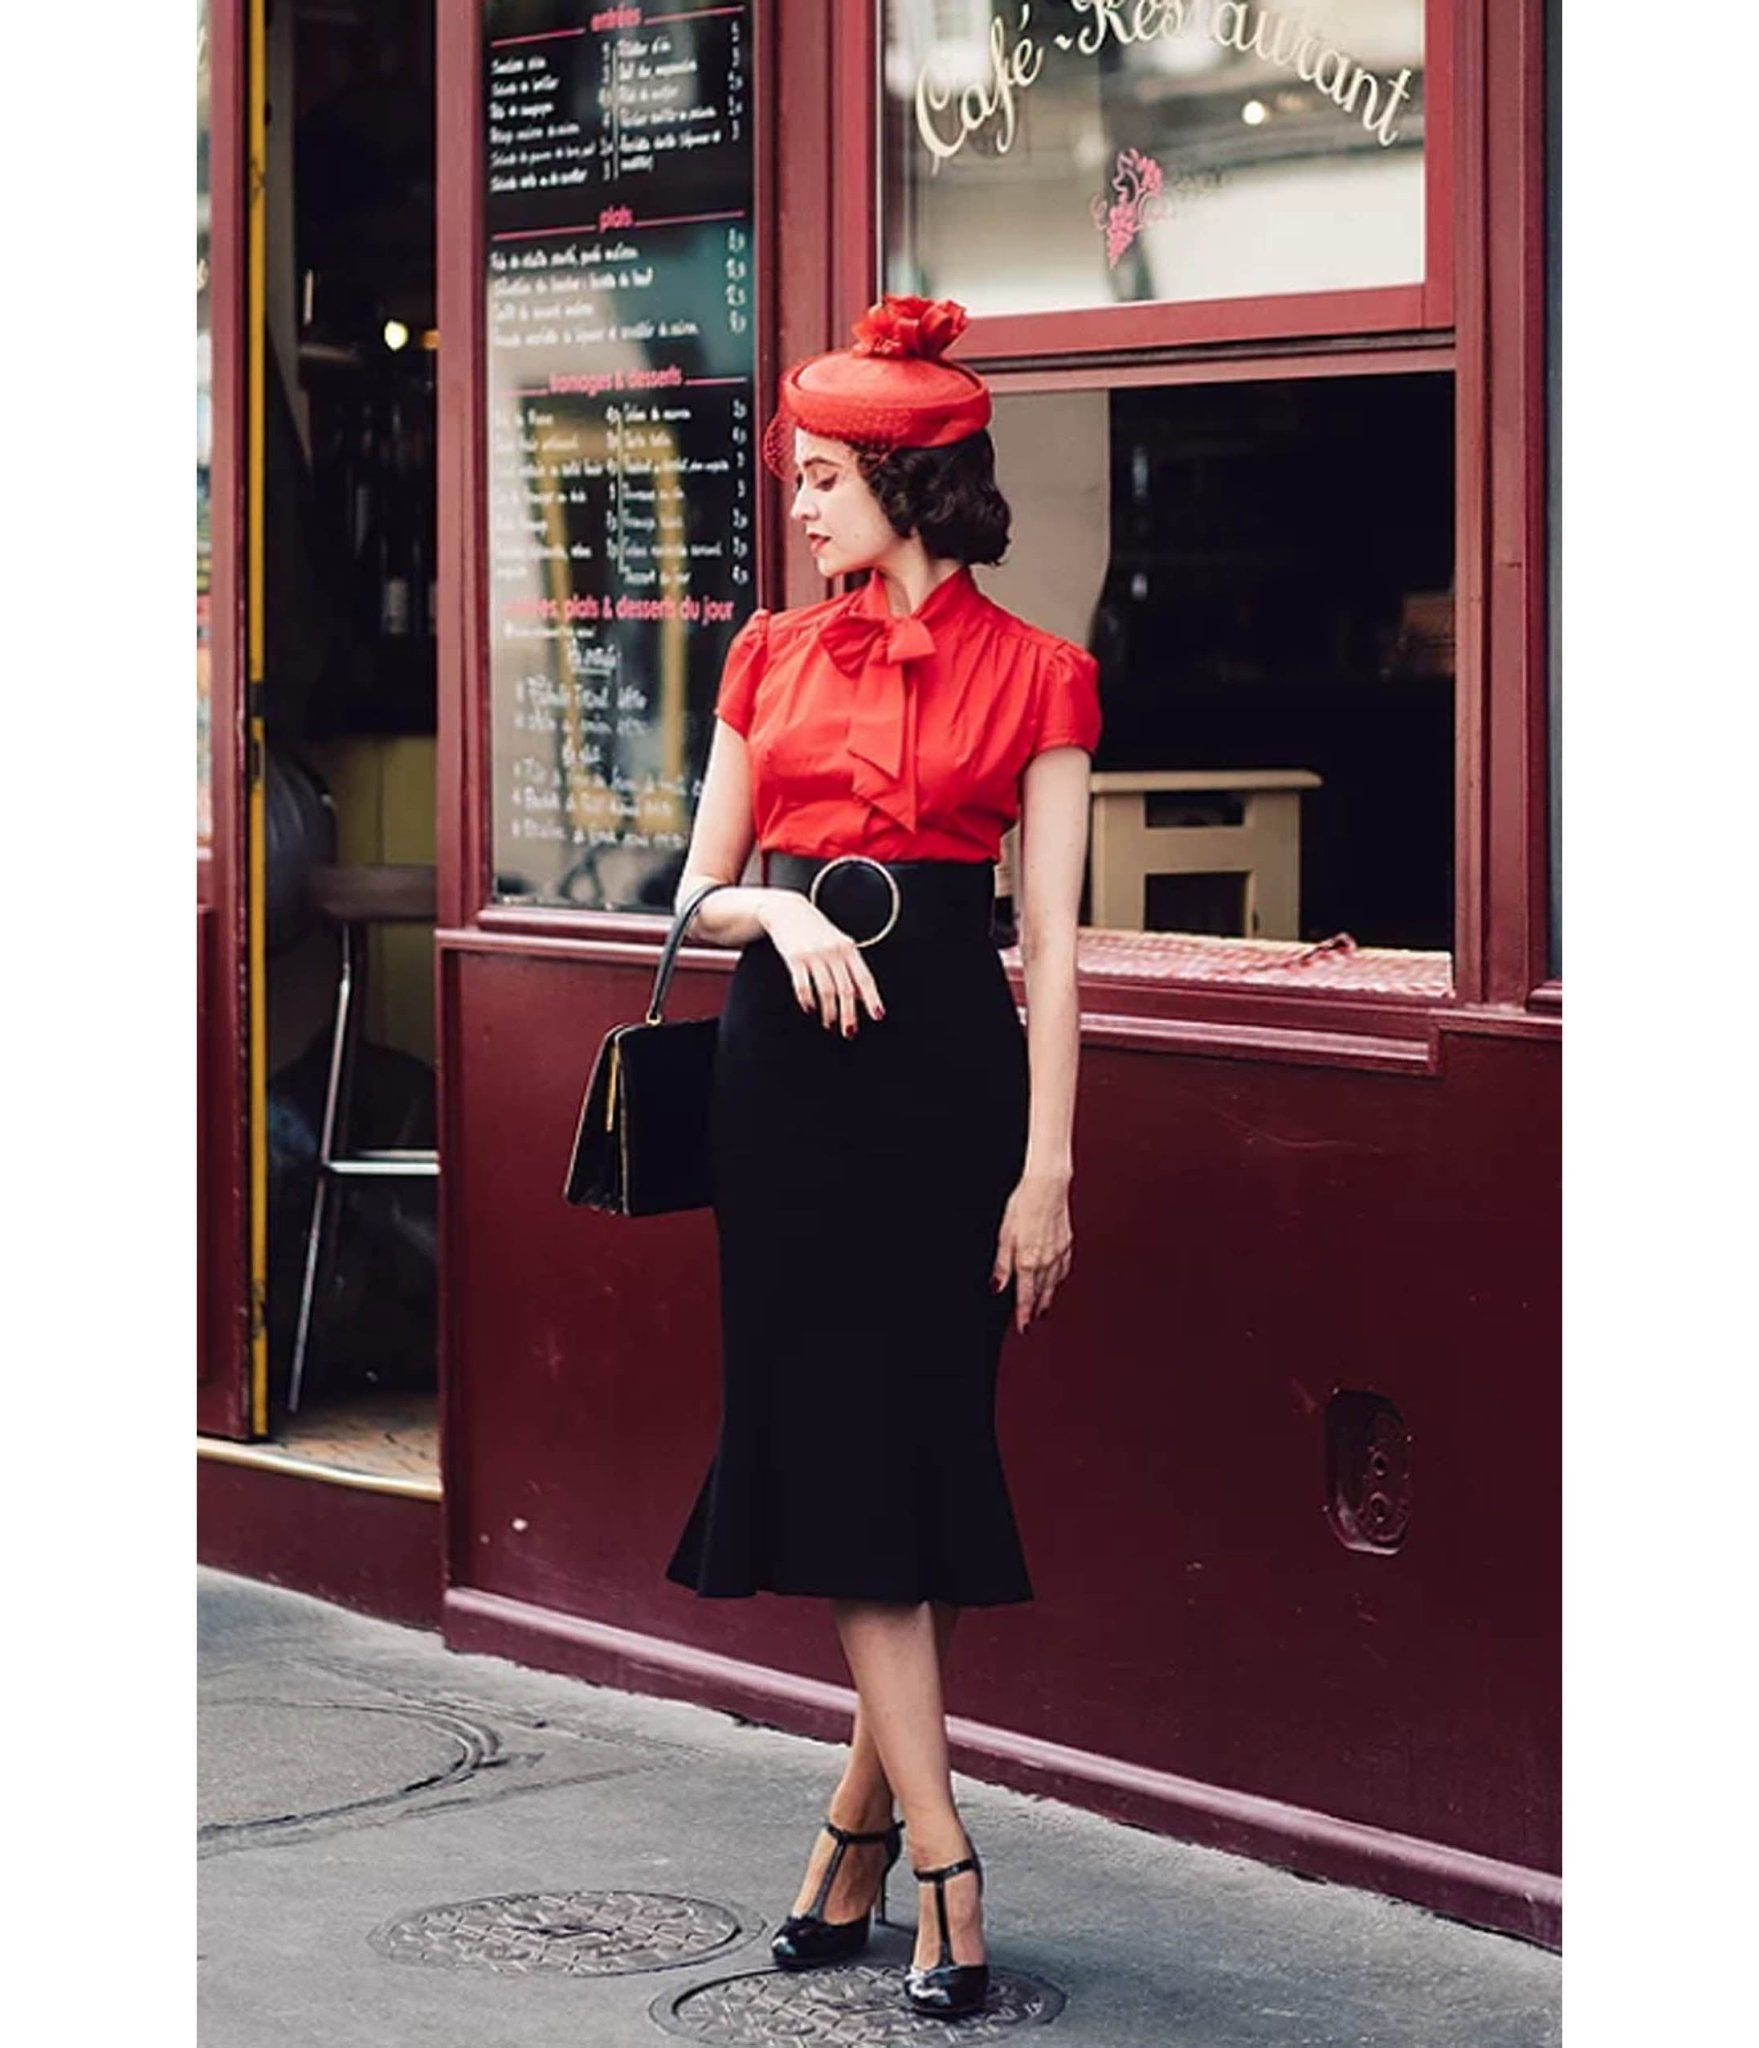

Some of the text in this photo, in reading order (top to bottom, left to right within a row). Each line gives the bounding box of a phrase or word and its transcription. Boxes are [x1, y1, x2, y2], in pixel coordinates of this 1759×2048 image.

[565, 594, 599, 621] plats
[615, 594, 677, 620] desserts
[680, 595, 700, 619] du
[703, 595, 735, 627] jour
